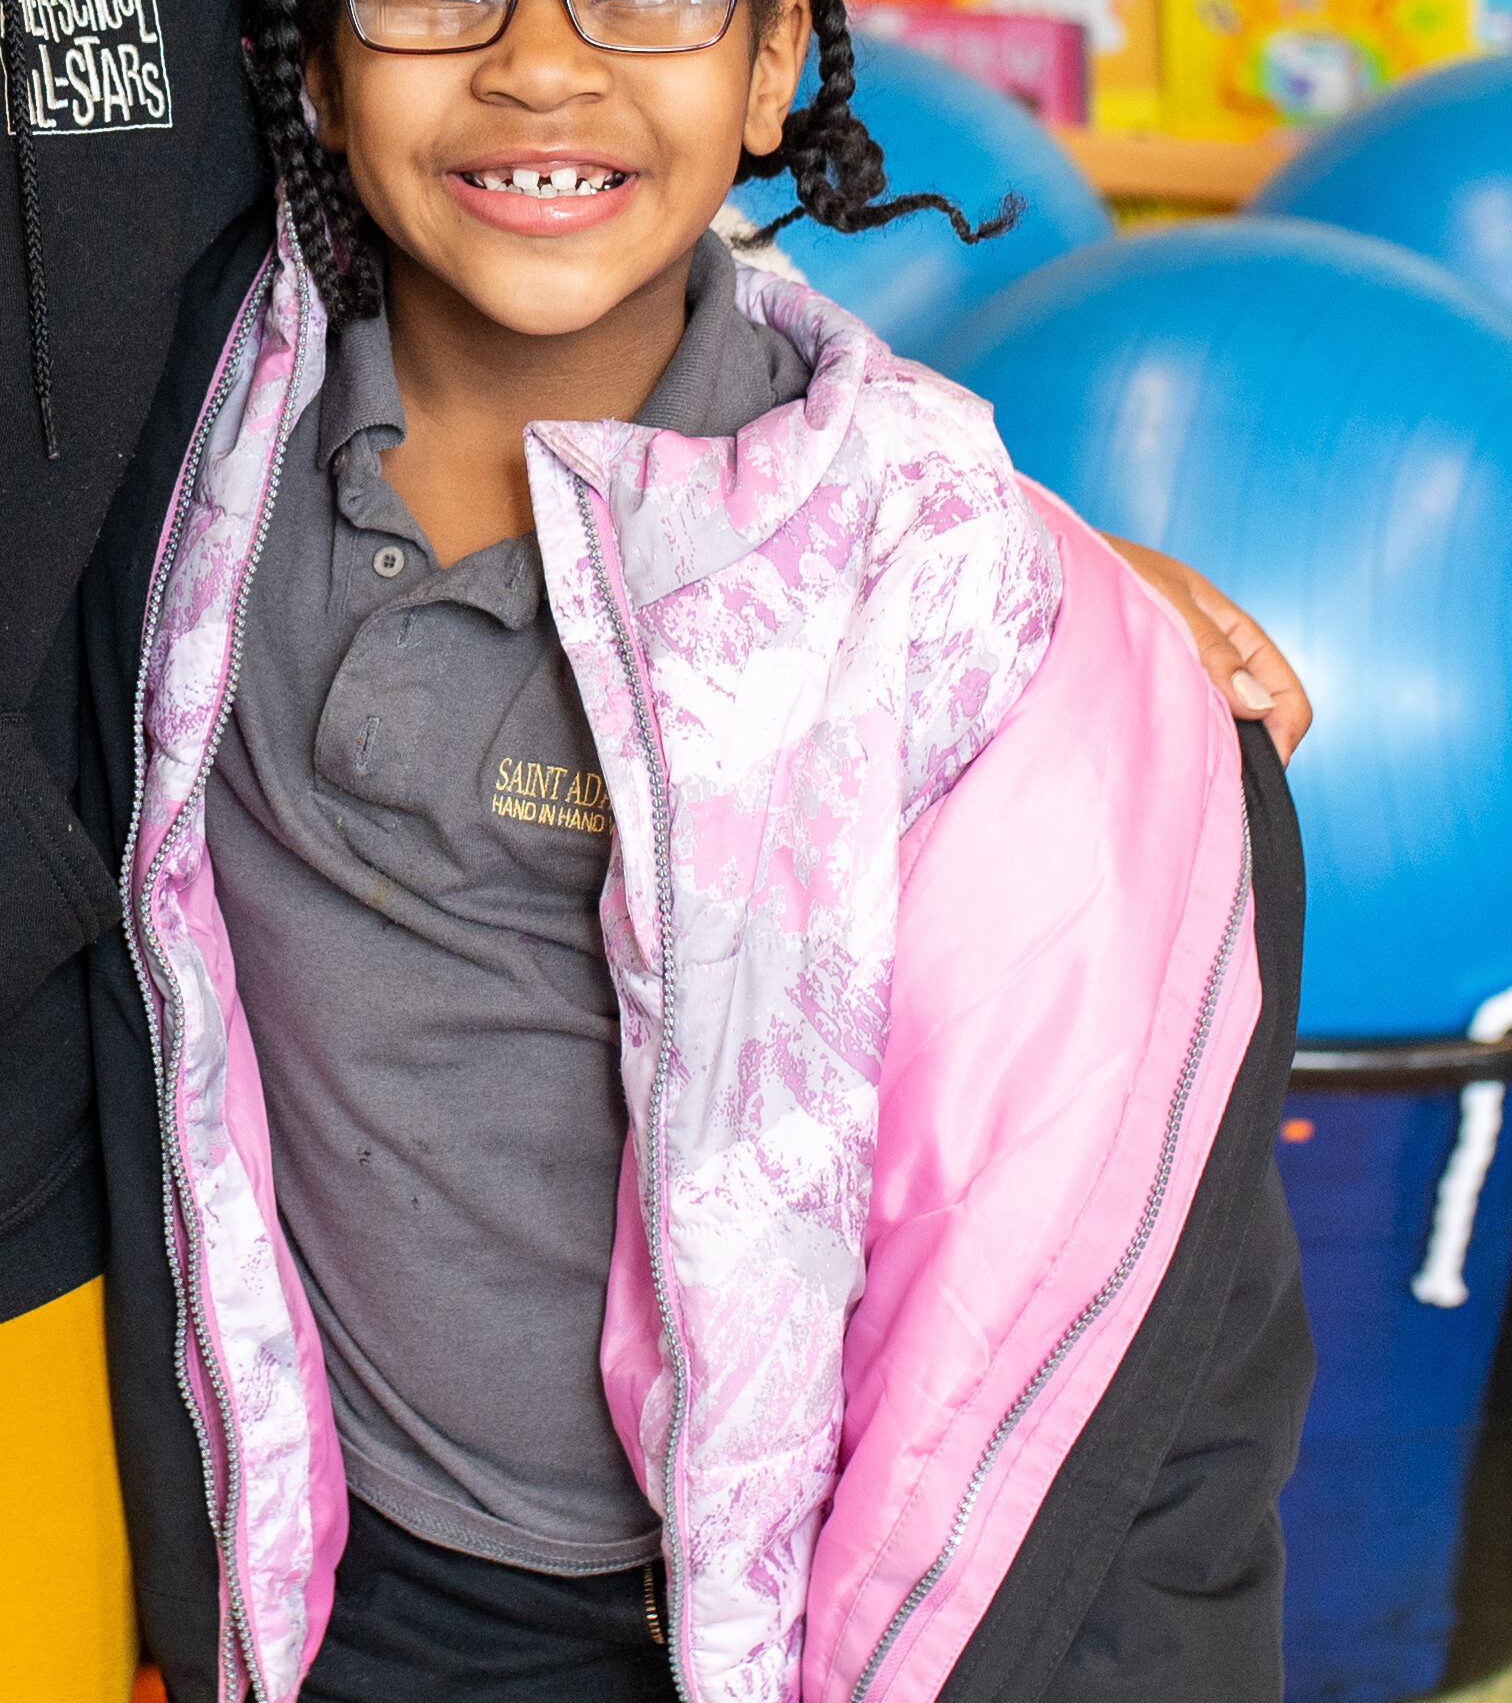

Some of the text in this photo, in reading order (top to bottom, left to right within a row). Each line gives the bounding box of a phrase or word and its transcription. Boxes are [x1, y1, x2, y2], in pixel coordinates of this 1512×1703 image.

[496, 757, 568, 800] SAINT
[491, 793, 537, 821] HAND
[537, 803, 557, 827] IN
[557, 806, 605, 833] HAND
